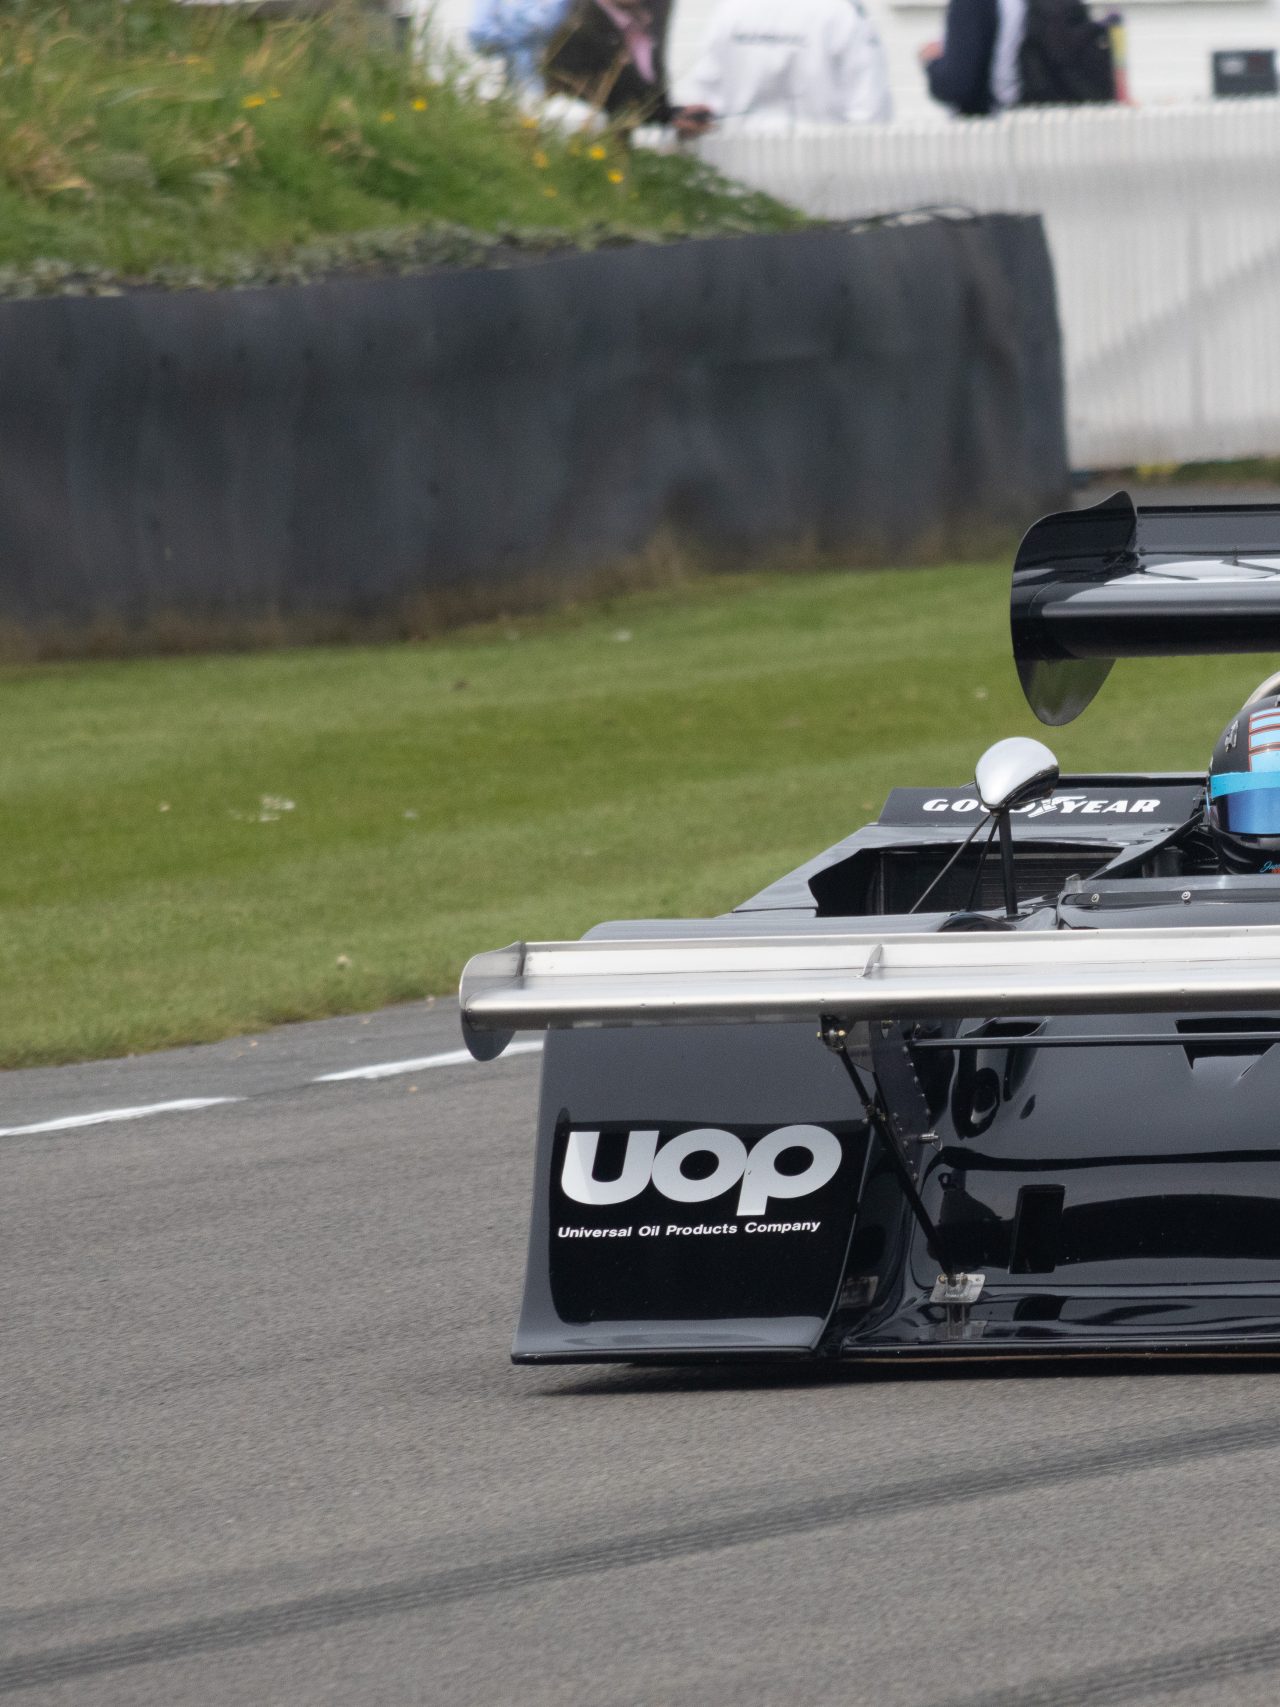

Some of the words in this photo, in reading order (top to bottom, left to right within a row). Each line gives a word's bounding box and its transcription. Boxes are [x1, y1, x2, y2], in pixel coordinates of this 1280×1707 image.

[558, 1226, 632, 1238] Universal
[638, 1225, 660, 1237] Oil
[666, 1223, 738, 1236] Products
[745, 1221, 821, 1235] Company
